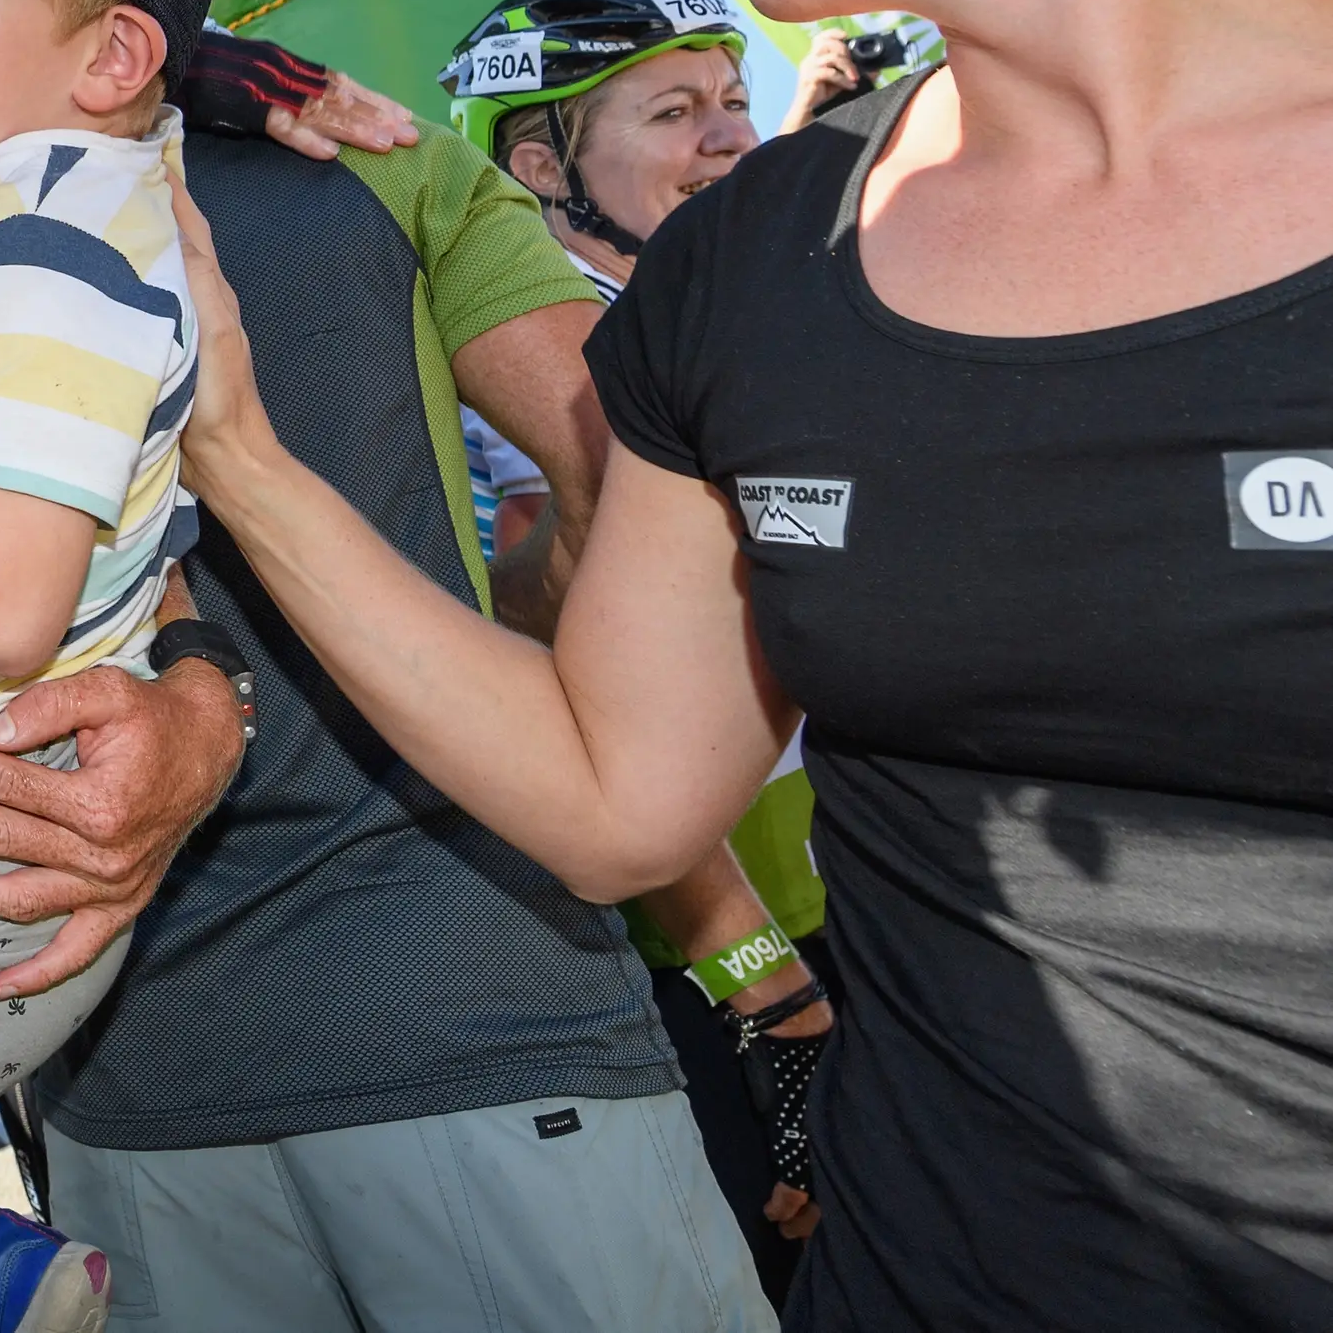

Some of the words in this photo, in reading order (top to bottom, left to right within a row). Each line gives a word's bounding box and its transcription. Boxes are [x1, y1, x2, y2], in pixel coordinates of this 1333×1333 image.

[477, 52, 536, 82] 760A
[740, 485, 772, 503] COAST
[775, 485, 785, 495] TO
[788, 486, 845, 506] COAST
[717, 929, 792, 981] 760A
